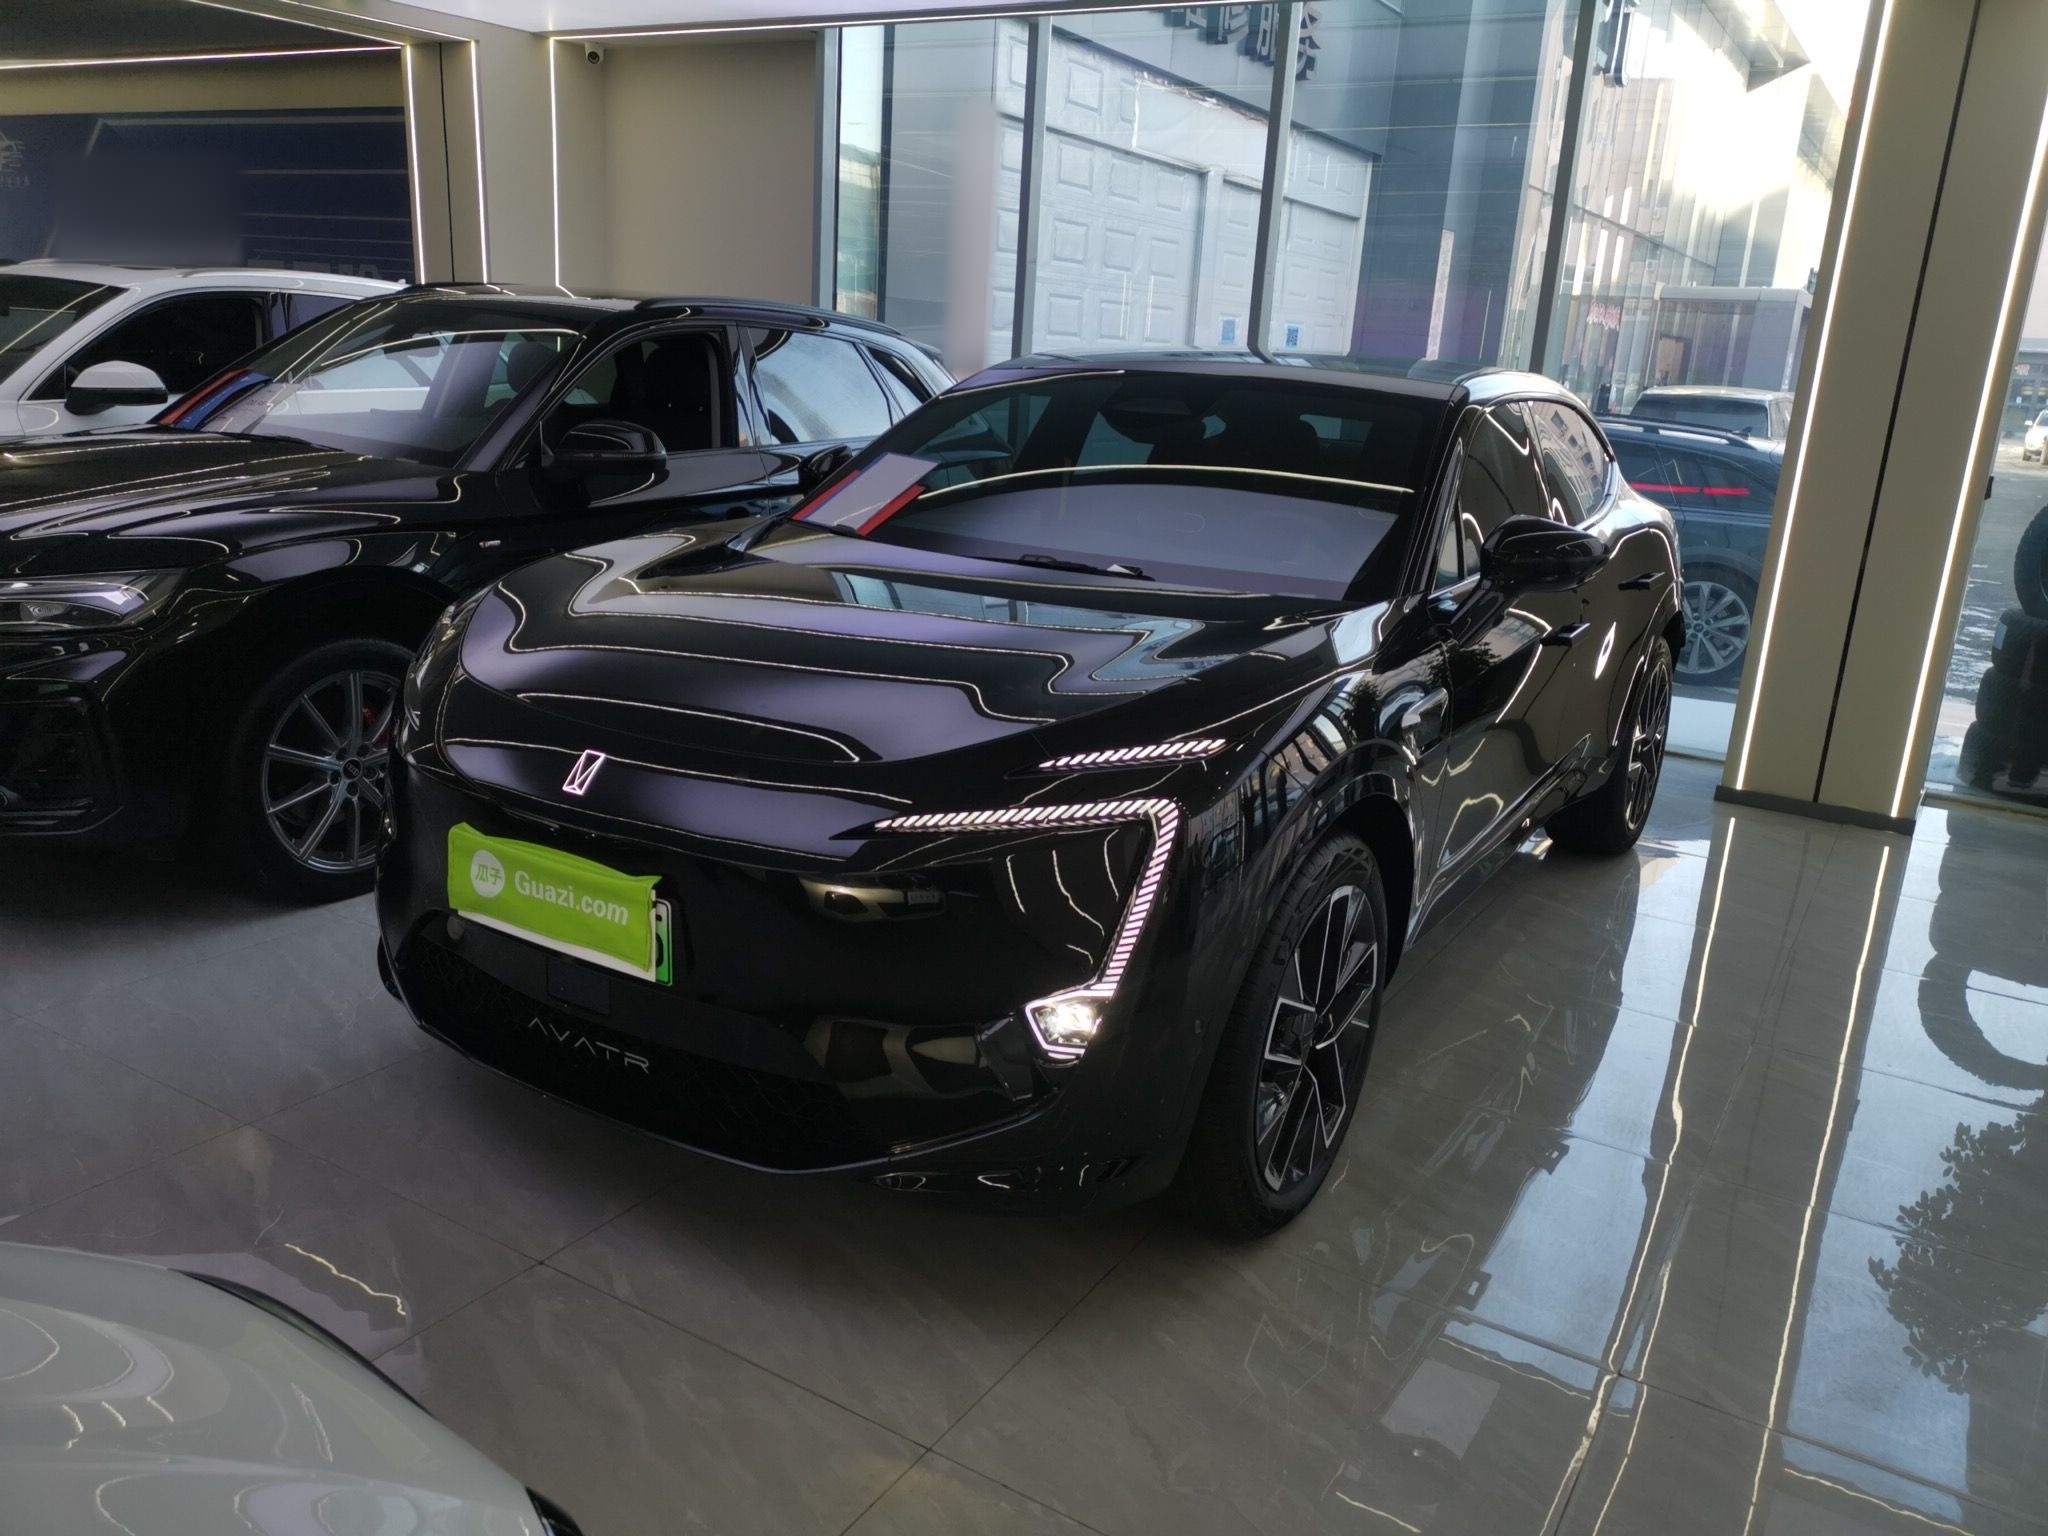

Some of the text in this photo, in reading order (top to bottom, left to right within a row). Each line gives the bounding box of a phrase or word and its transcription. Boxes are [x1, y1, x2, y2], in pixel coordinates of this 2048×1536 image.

[475, 863, 502, 885] 瓜子
[515, 871, 629, 926] Guazi.com
[529, 1017, 649, 1073] AVATR
